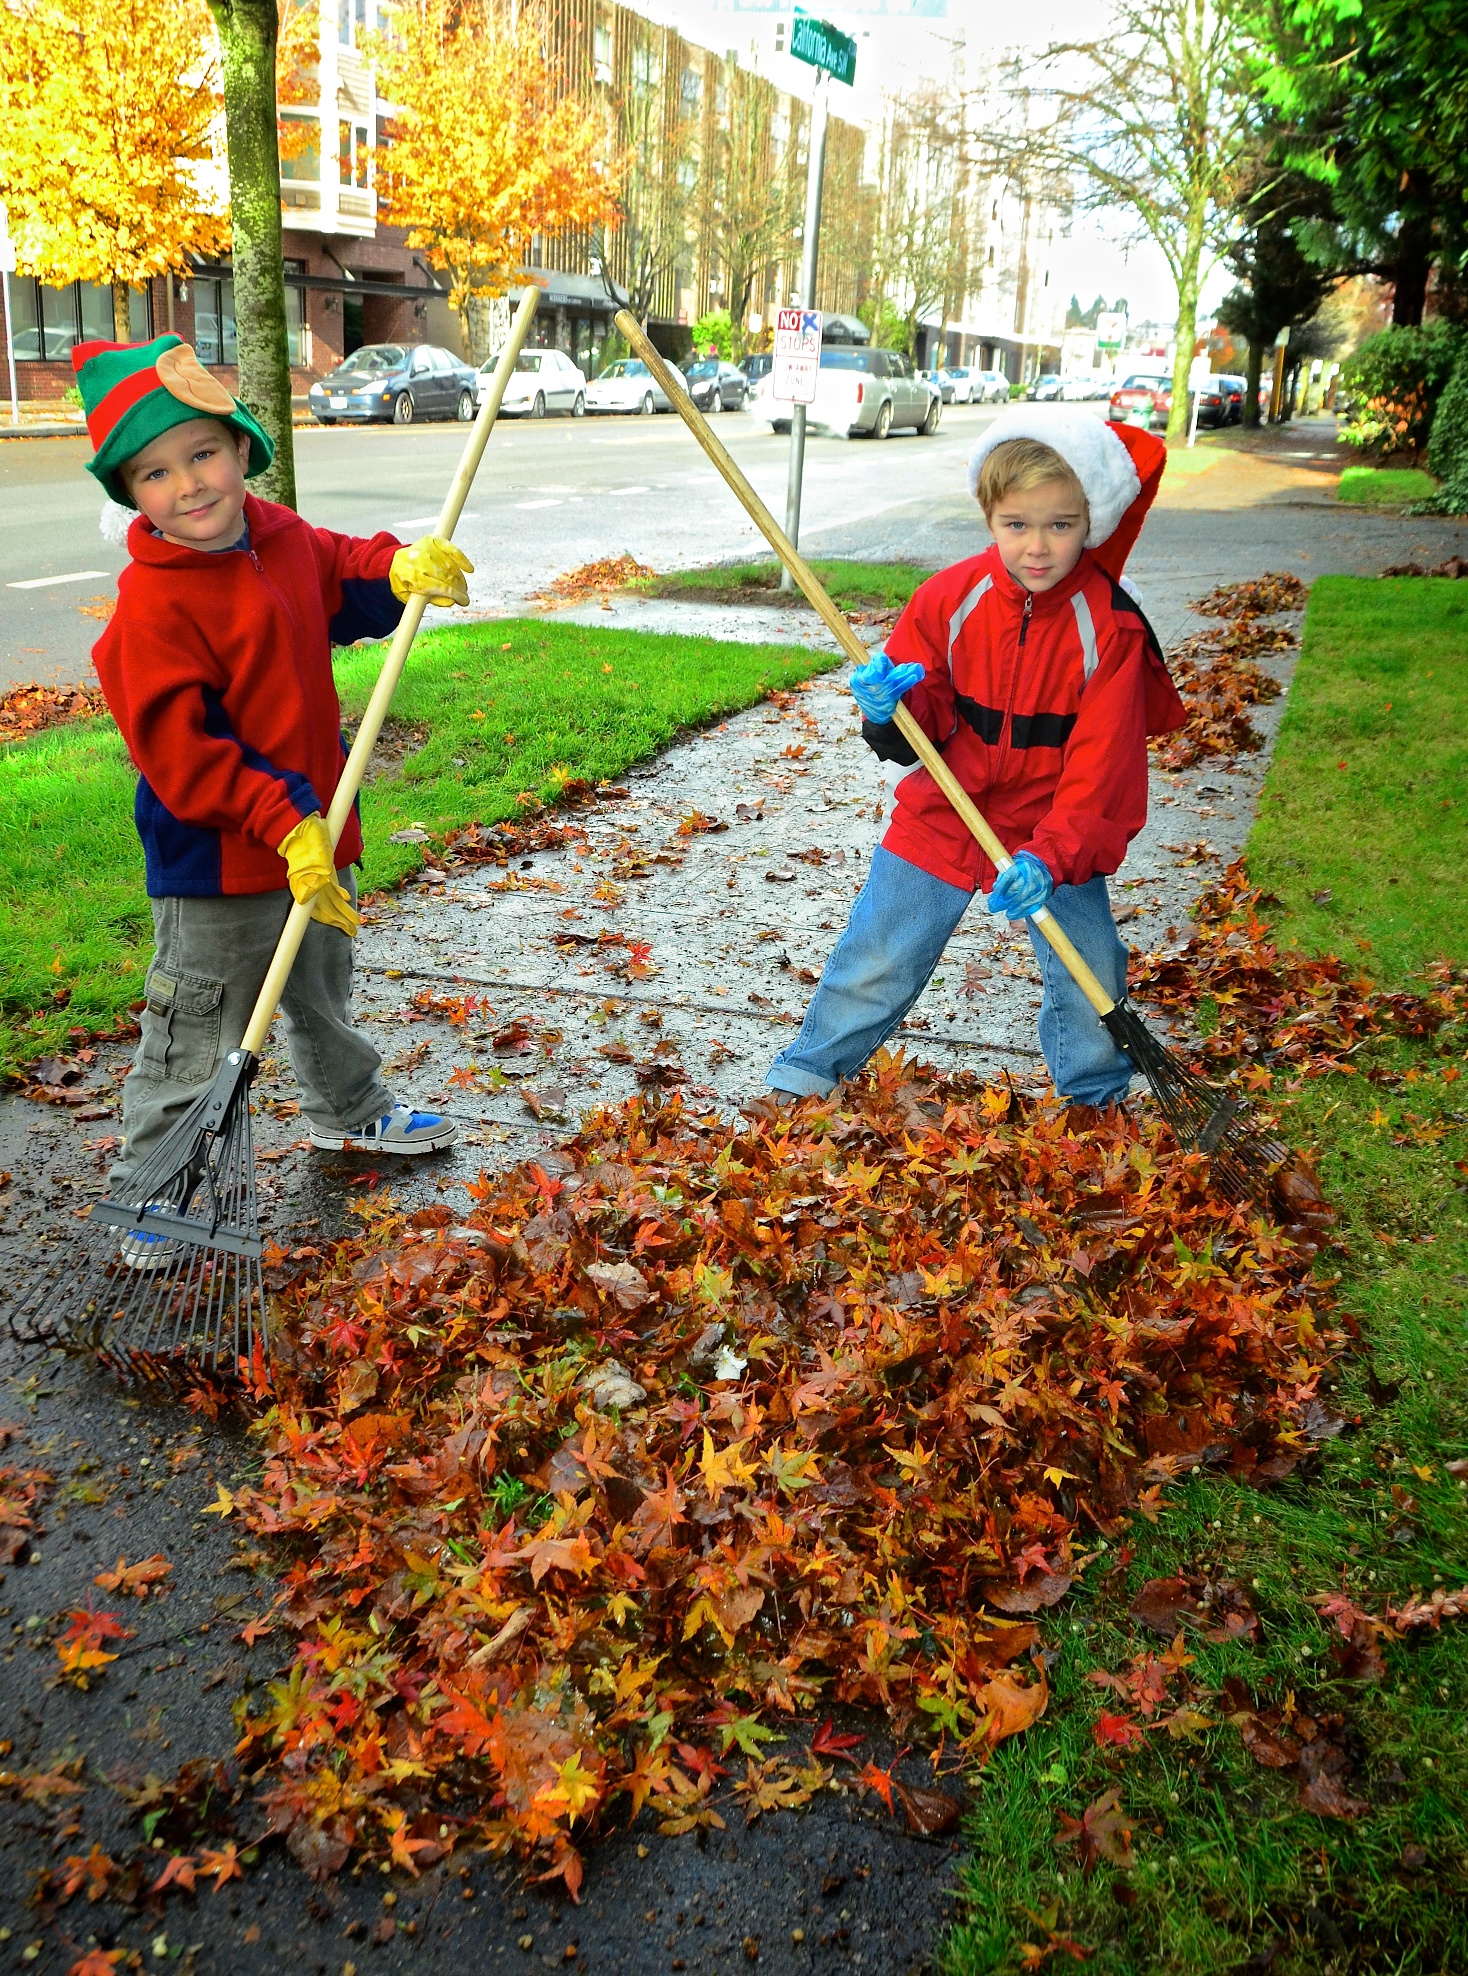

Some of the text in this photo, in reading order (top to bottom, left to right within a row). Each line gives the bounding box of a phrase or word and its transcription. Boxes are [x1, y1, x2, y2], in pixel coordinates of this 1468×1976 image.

[792, 17, 826, 64] California
[781, 312, 797, 329] NO
[780, 336, 816, 352] STOPS
